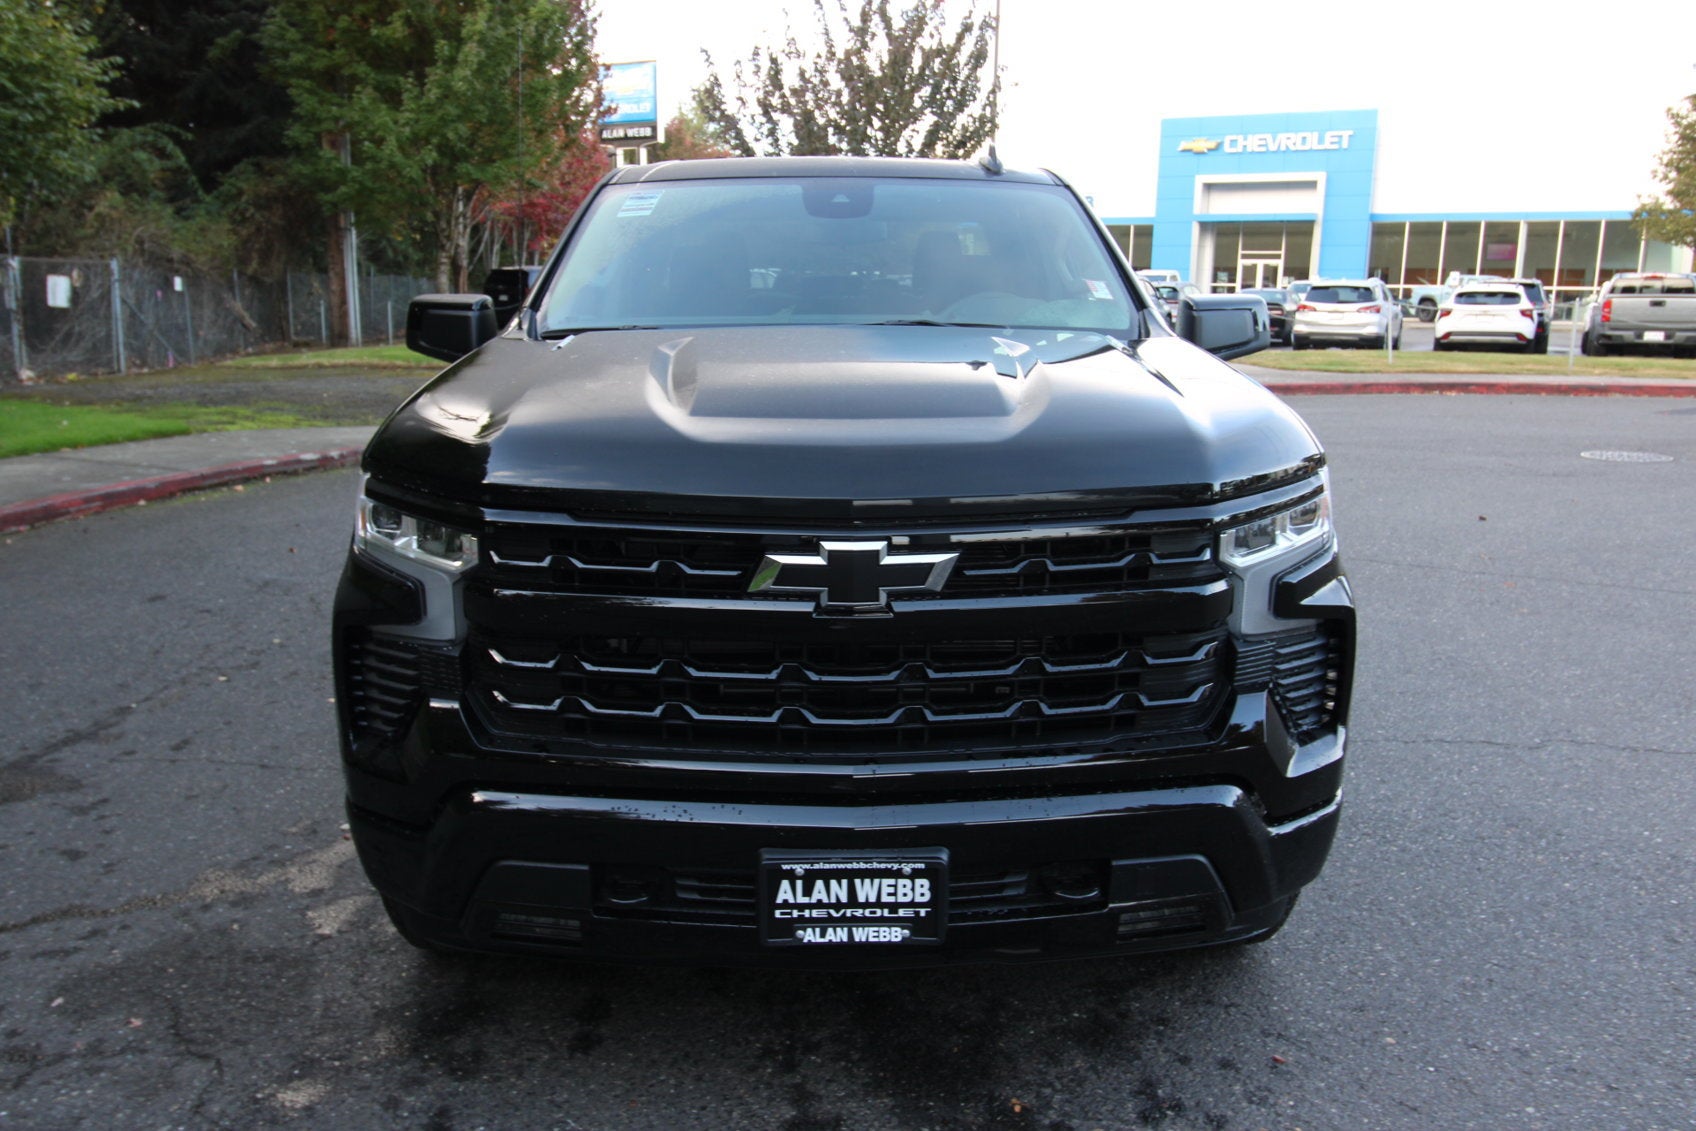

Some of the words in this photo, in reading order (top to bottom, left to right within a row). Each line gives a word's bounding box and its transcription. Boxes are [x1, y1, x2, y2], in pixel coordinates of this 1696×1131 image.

[601, 127, 625, 139] ALAN
[626, 126, 652, 137] WEBB
[1223, 130, 1354, 153] CHEVROLET
[781, 861, 926, 871] www.alanwebbchevy.com
[775, 879, 848, 903] ALAN
[854, 878, 931, 903] WEBB
[774, 908, 932, 918] CHEVROLET
[803, 927, 848, 943] ALAN
[852, 927, 903, 942] WEBB
